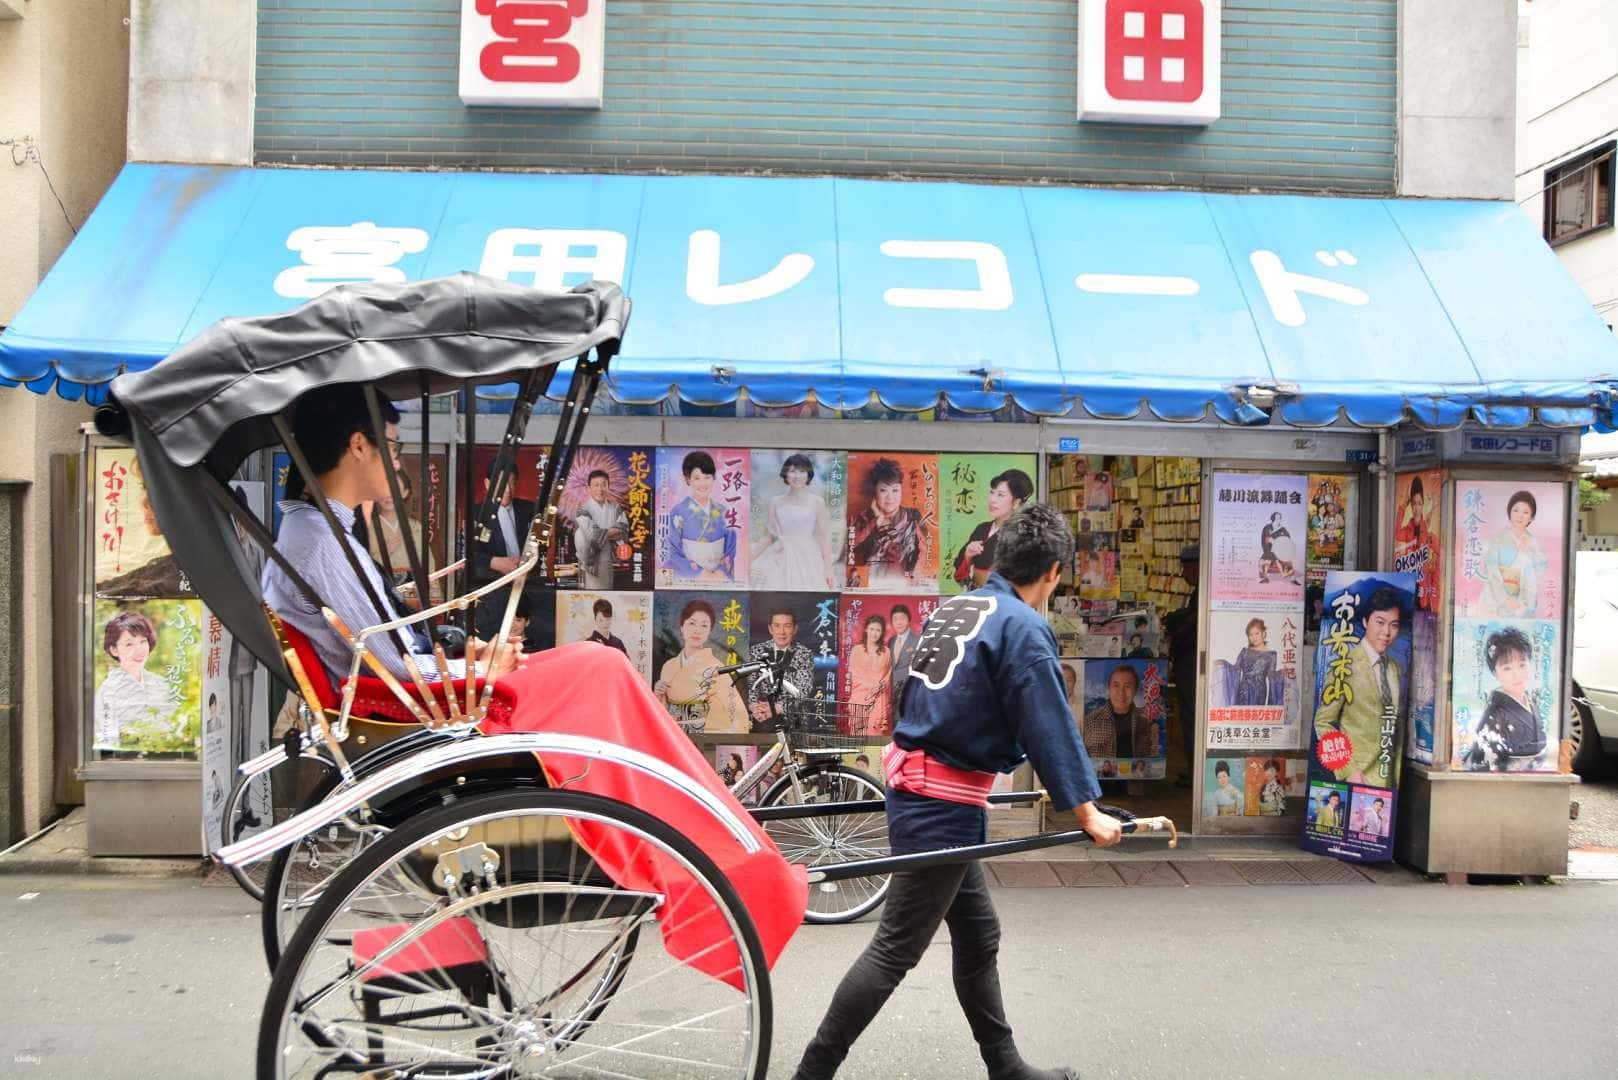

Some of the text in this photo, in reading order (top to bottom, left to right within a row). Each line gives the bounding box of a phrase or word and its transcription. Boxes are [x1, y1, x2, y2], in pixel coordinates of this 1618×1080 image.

[721, 458, 748, 529] 一路一生
[1281, 617, 1297, 680] 八代亜紀
[1223, 727, 1271, 738] 浅草公会堂
[1378, 706, 1398, 778] 三山ひろし
